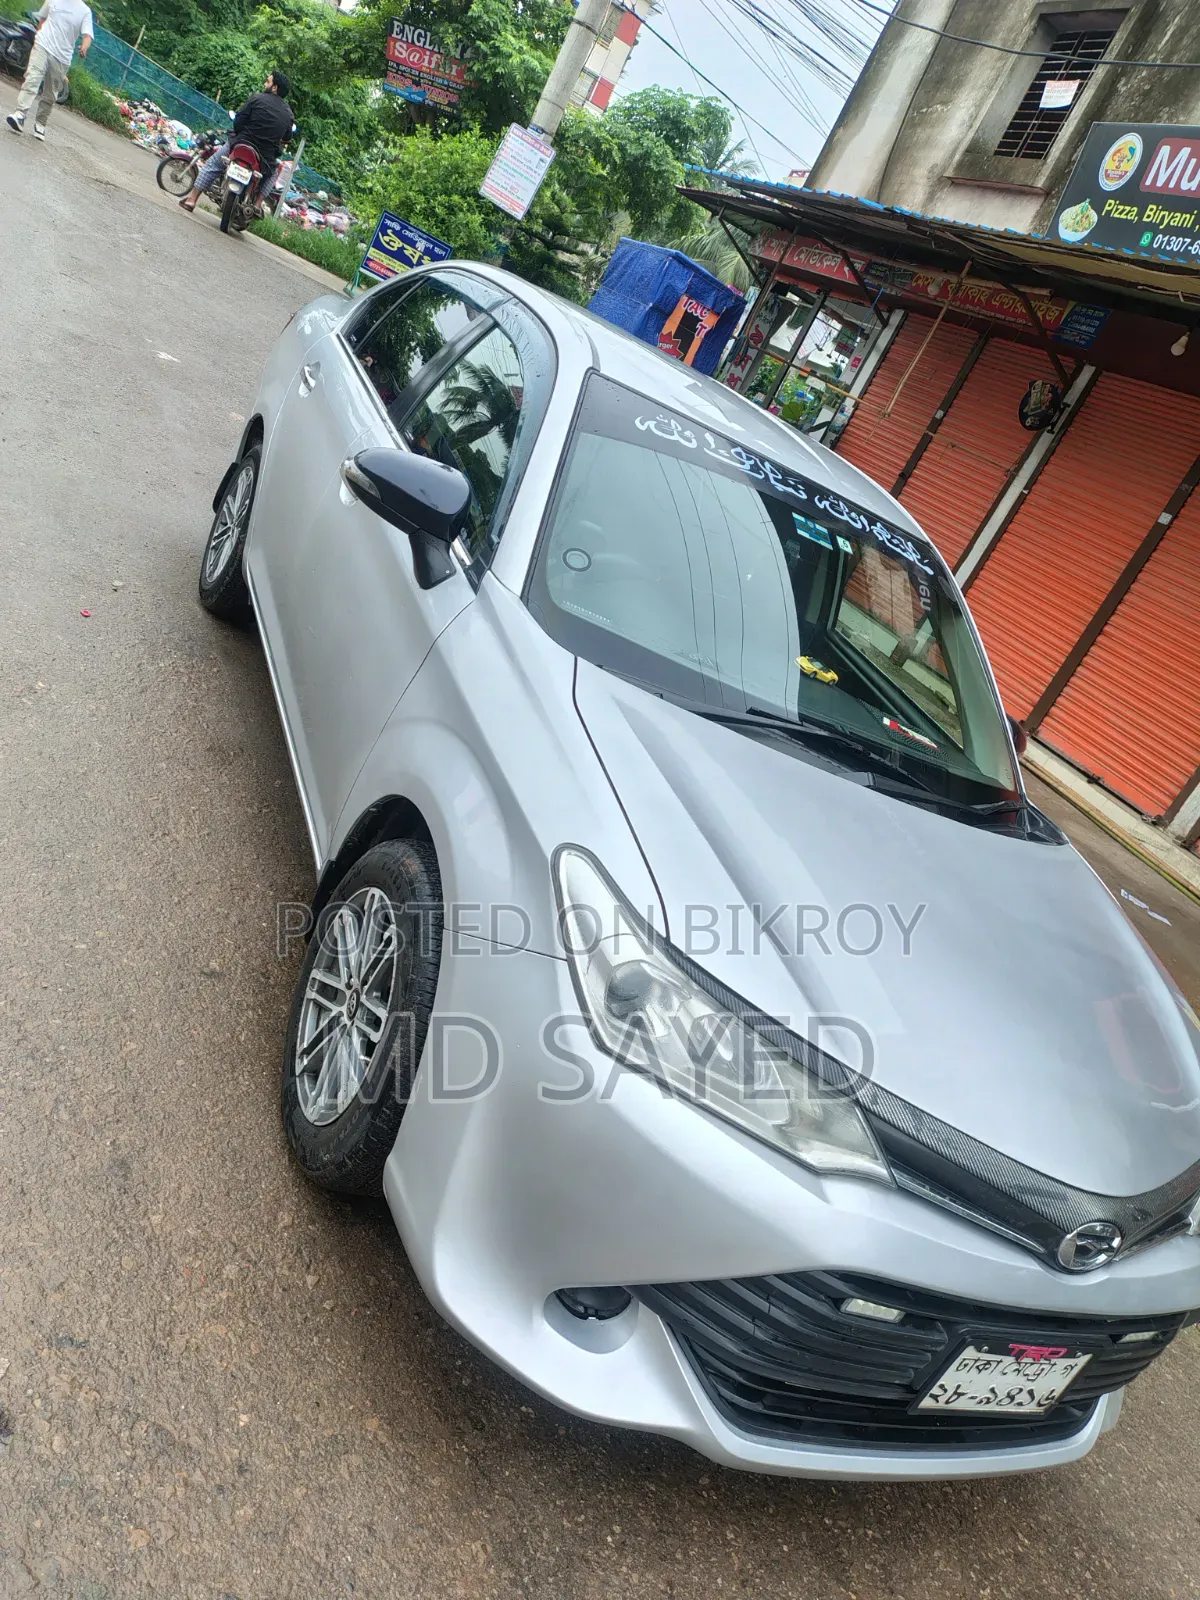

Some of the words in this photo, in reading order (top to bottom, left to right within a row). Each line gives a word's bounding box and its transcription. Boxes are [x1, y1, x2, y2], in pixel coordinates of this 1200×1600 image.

[1102, 199, 1138, 223] Pizza,
[794, 243, 843, 272] মেডিকেল
[1008, 1343, 1068, 1363] TRD
[955, 1356, 1003, 1375] ঢাকা
